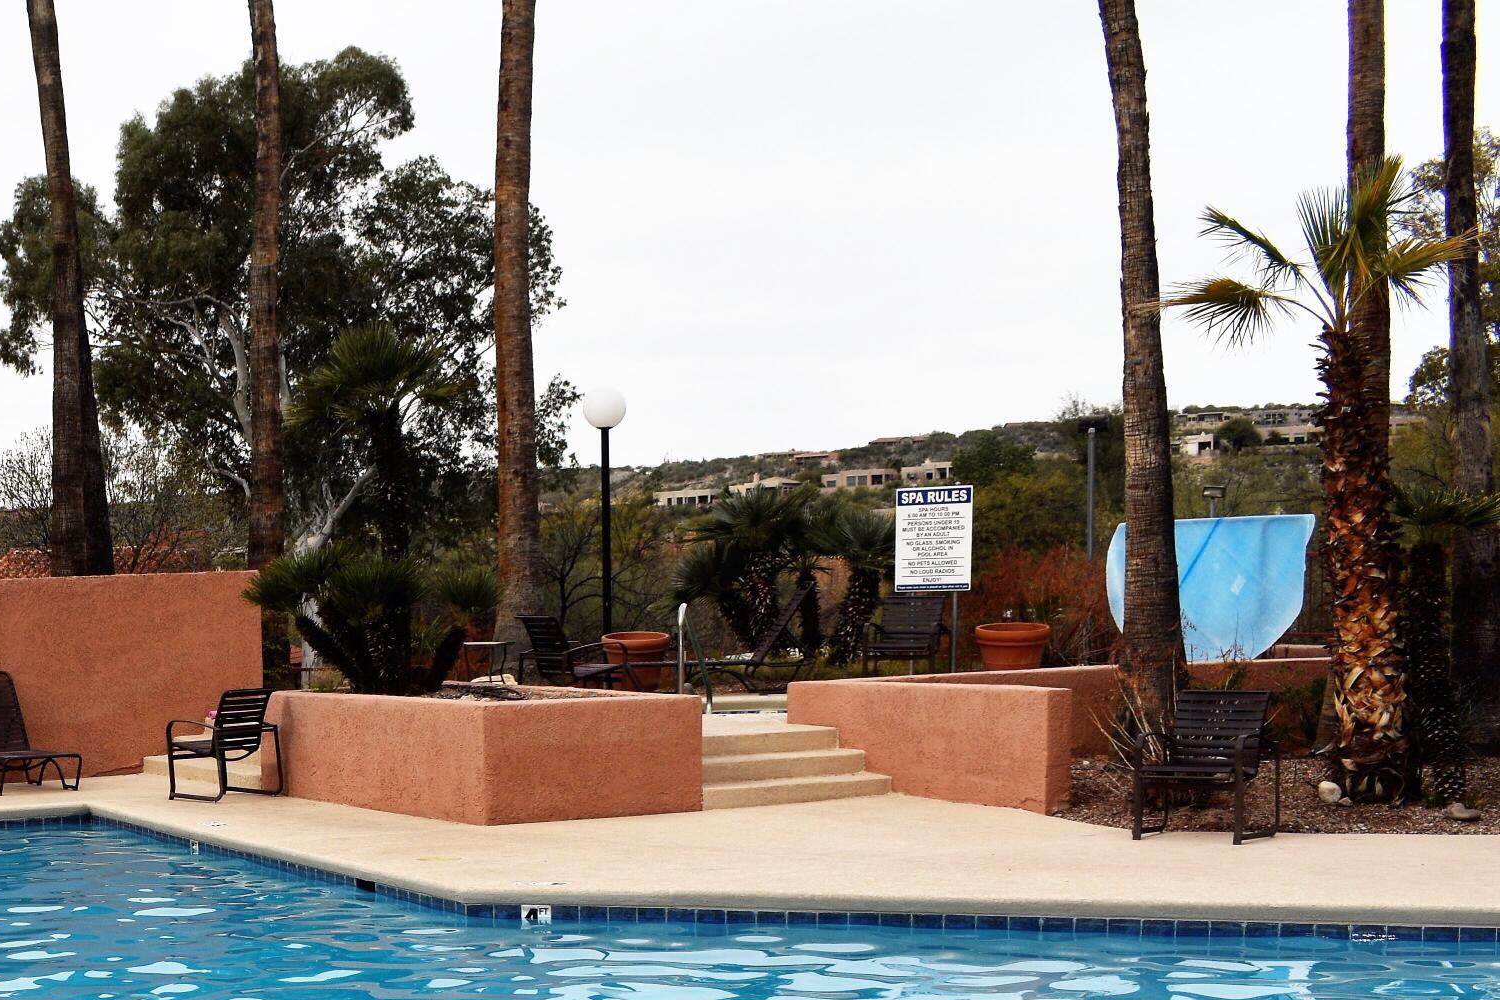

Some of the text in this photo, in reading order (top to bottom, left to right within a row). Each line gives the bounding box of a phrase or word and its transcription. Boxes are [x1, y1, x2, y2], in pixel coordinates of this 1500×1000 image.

[901, 490, 968, 504] SPA RULES
[539, 908, 549, 916] FT
